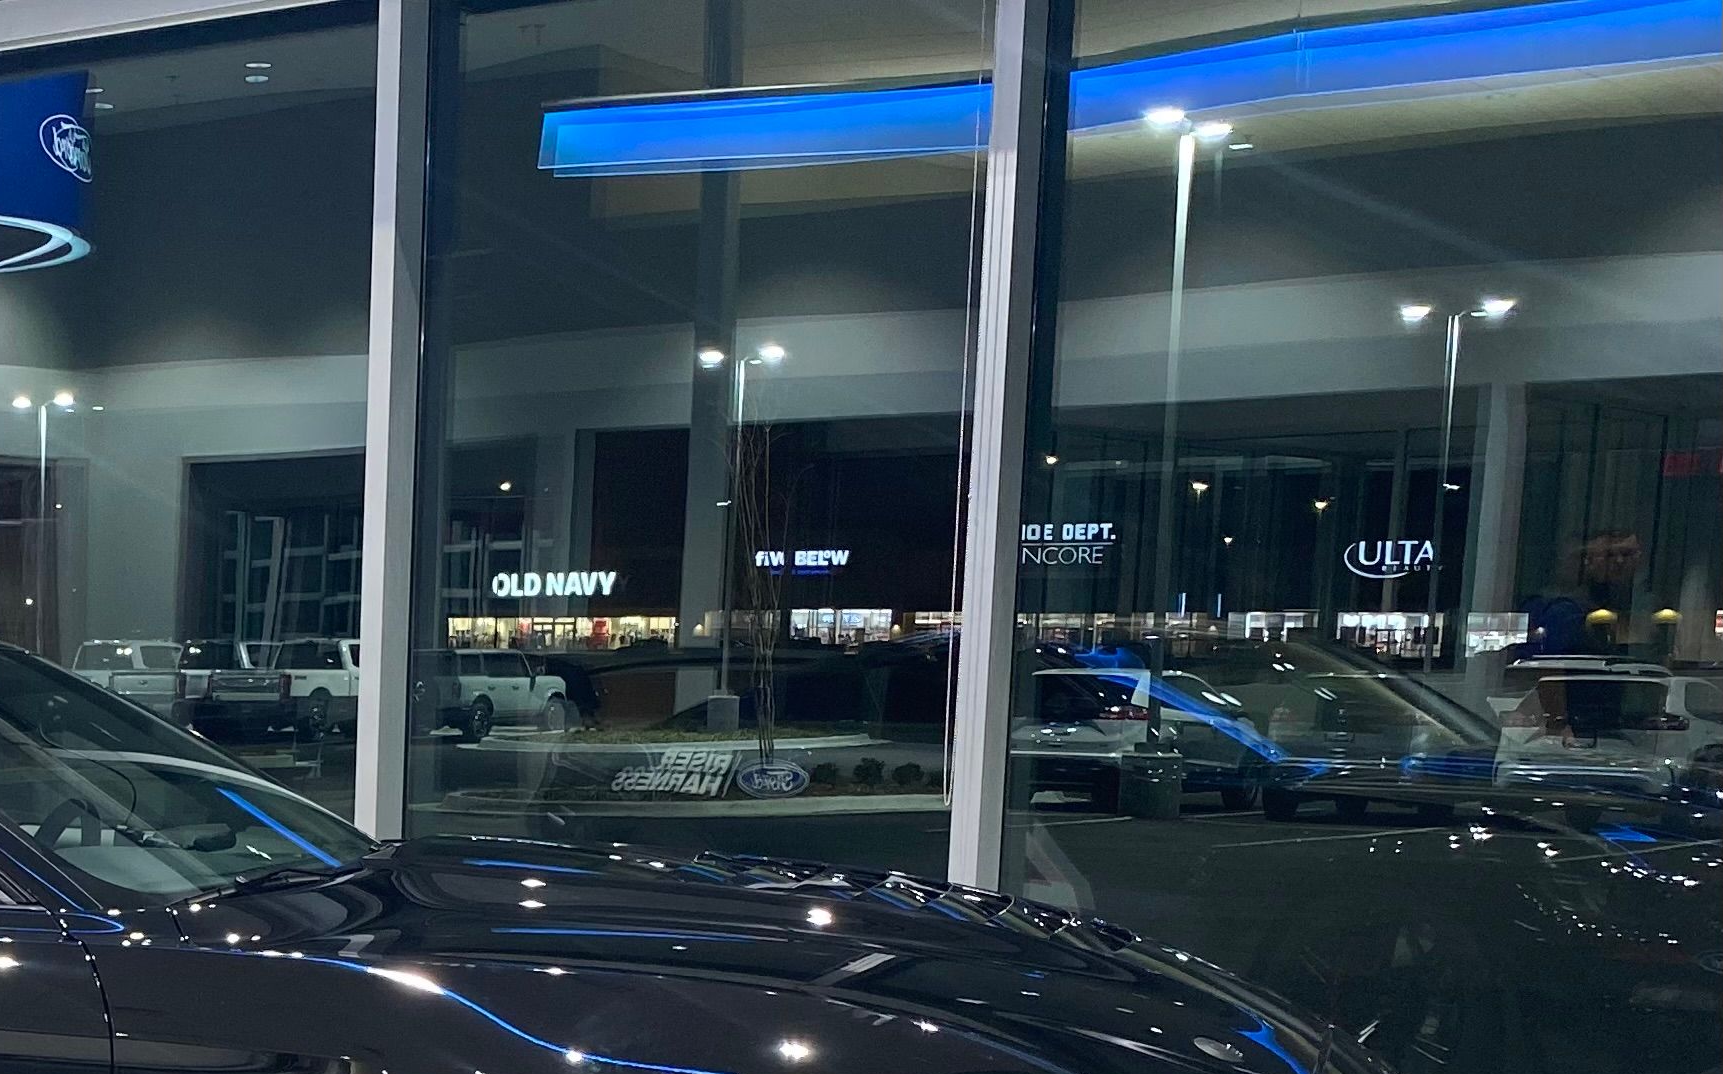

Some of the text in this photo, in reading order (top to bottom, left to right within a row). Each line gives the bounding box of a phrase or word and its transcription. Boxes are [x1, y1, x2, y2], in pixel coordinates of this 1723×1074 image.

[1021, 522, 1117, 541] OE DEPT.
[1021, 546, 1104, 565] NCORE
[1358, 539, 1434, 566] ULTA
[491, 571, 617, 597] OLD NAVY
